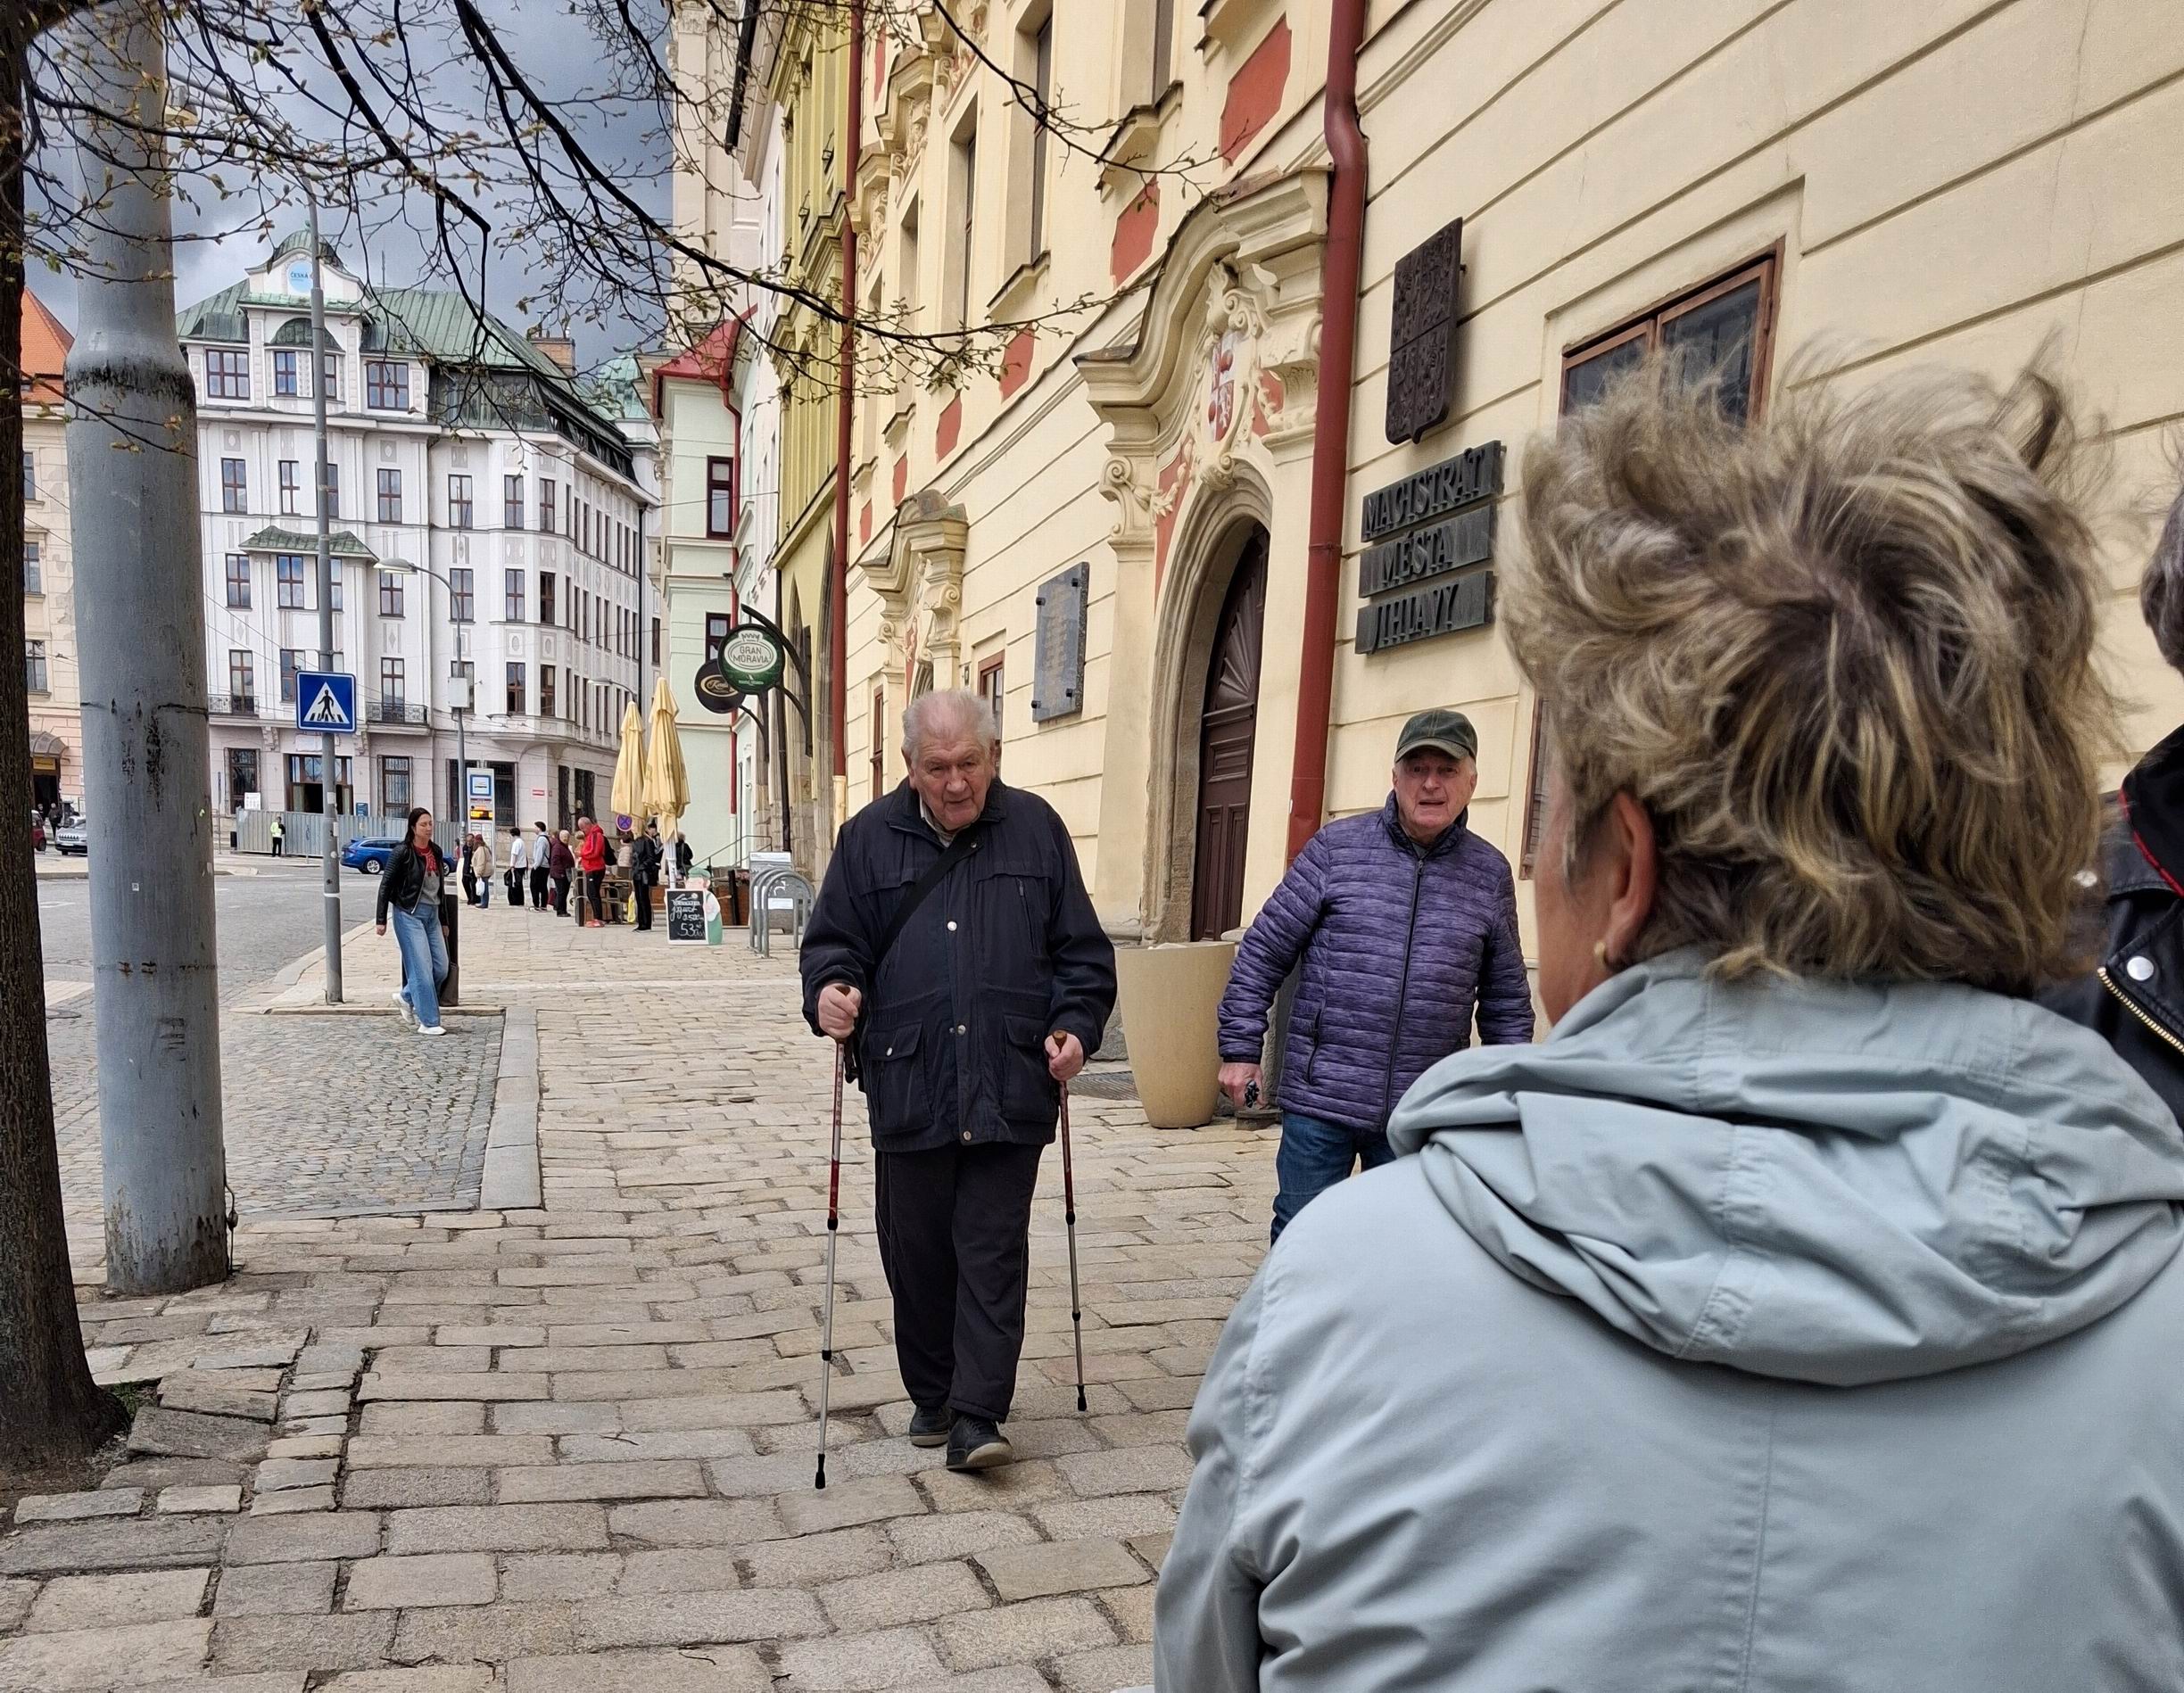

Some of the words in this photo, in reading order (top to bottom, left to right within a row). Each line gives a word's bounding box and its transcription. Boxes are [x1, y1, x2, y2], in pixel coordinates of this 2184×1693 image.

[1365, 448, 1485, 537] MAGISTRÁT
[1369, 583, 1460, 654] JIHLAVY
[732, 654, 769, 663] MORAVIA
[740, 646, 762, 655] GRAN
